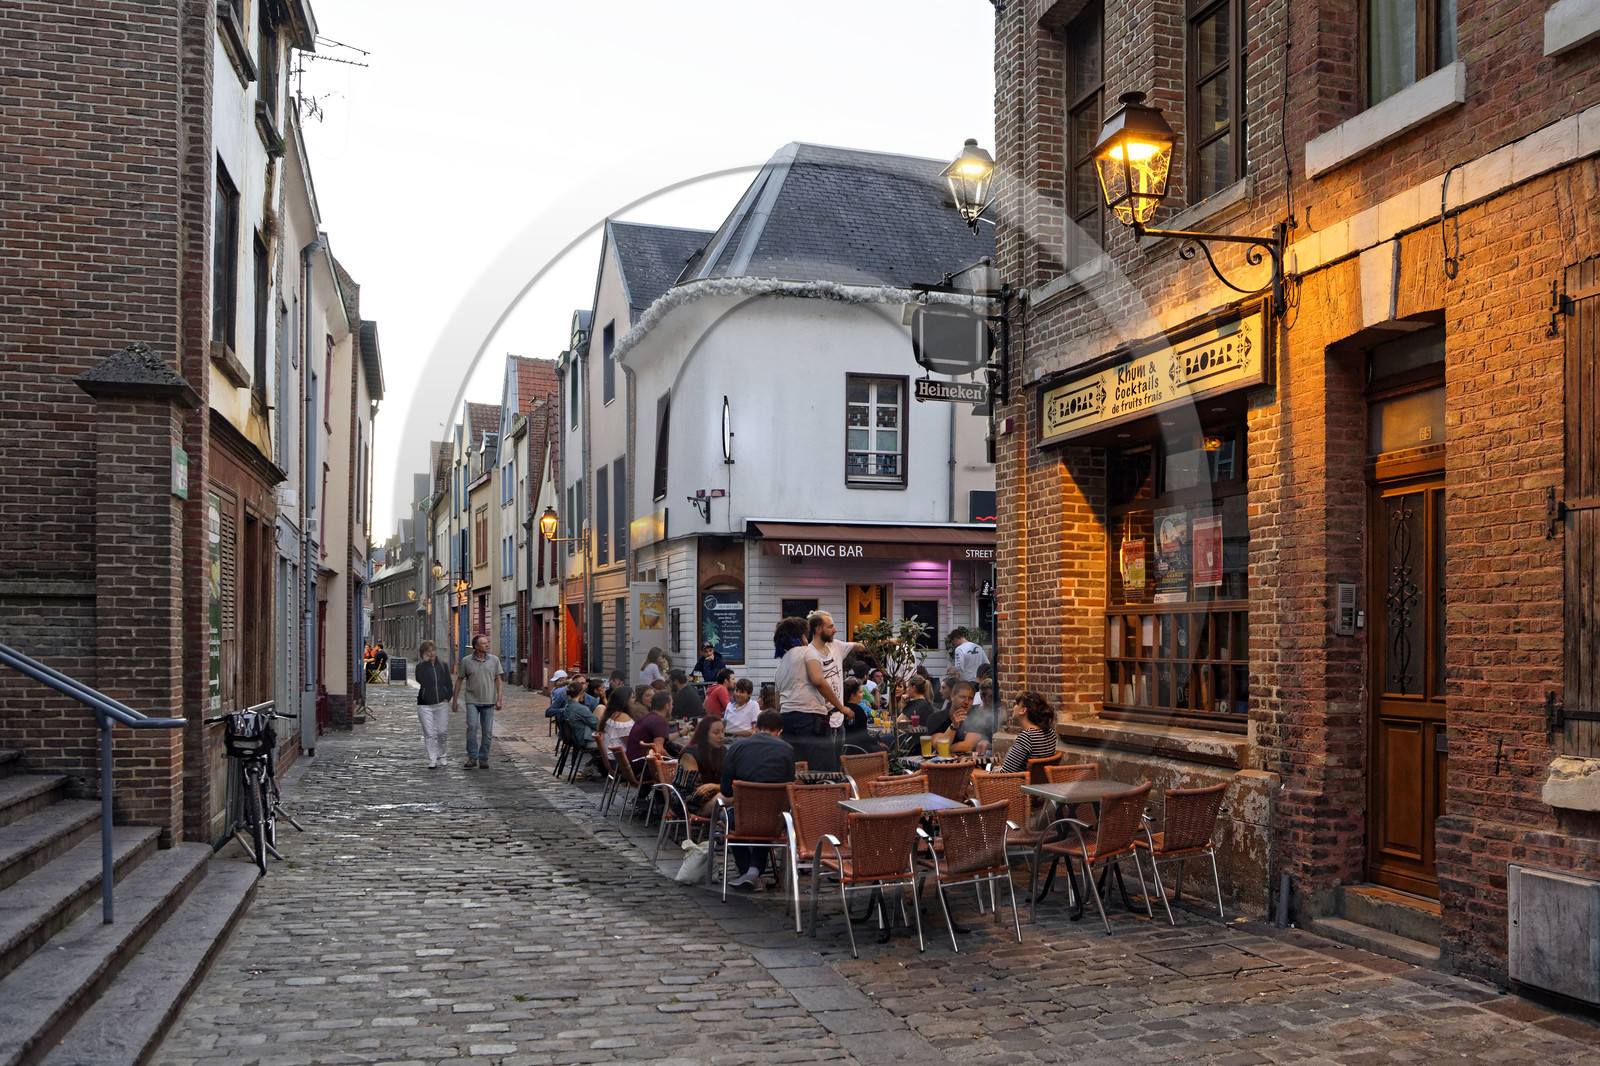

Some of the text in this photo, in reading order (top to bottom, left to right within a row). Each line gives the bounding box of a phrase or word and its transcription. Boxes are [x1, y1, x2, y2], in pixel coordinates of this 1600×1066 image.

[1186, 343, 1232, 375] BAOBAR
[1117, 361, 1157, 385] Rhum &
[918, 381, 982, 400] Heineken
[1115, 375, 1160, 401] Cocktails
[1060, 392, 1094, 418] BAOBAR
[1111, 390, 1163, 414] de fruits frais
[779, 543, 864, 557] TRADING BAR
[965, 549, 994, 558] STREET
